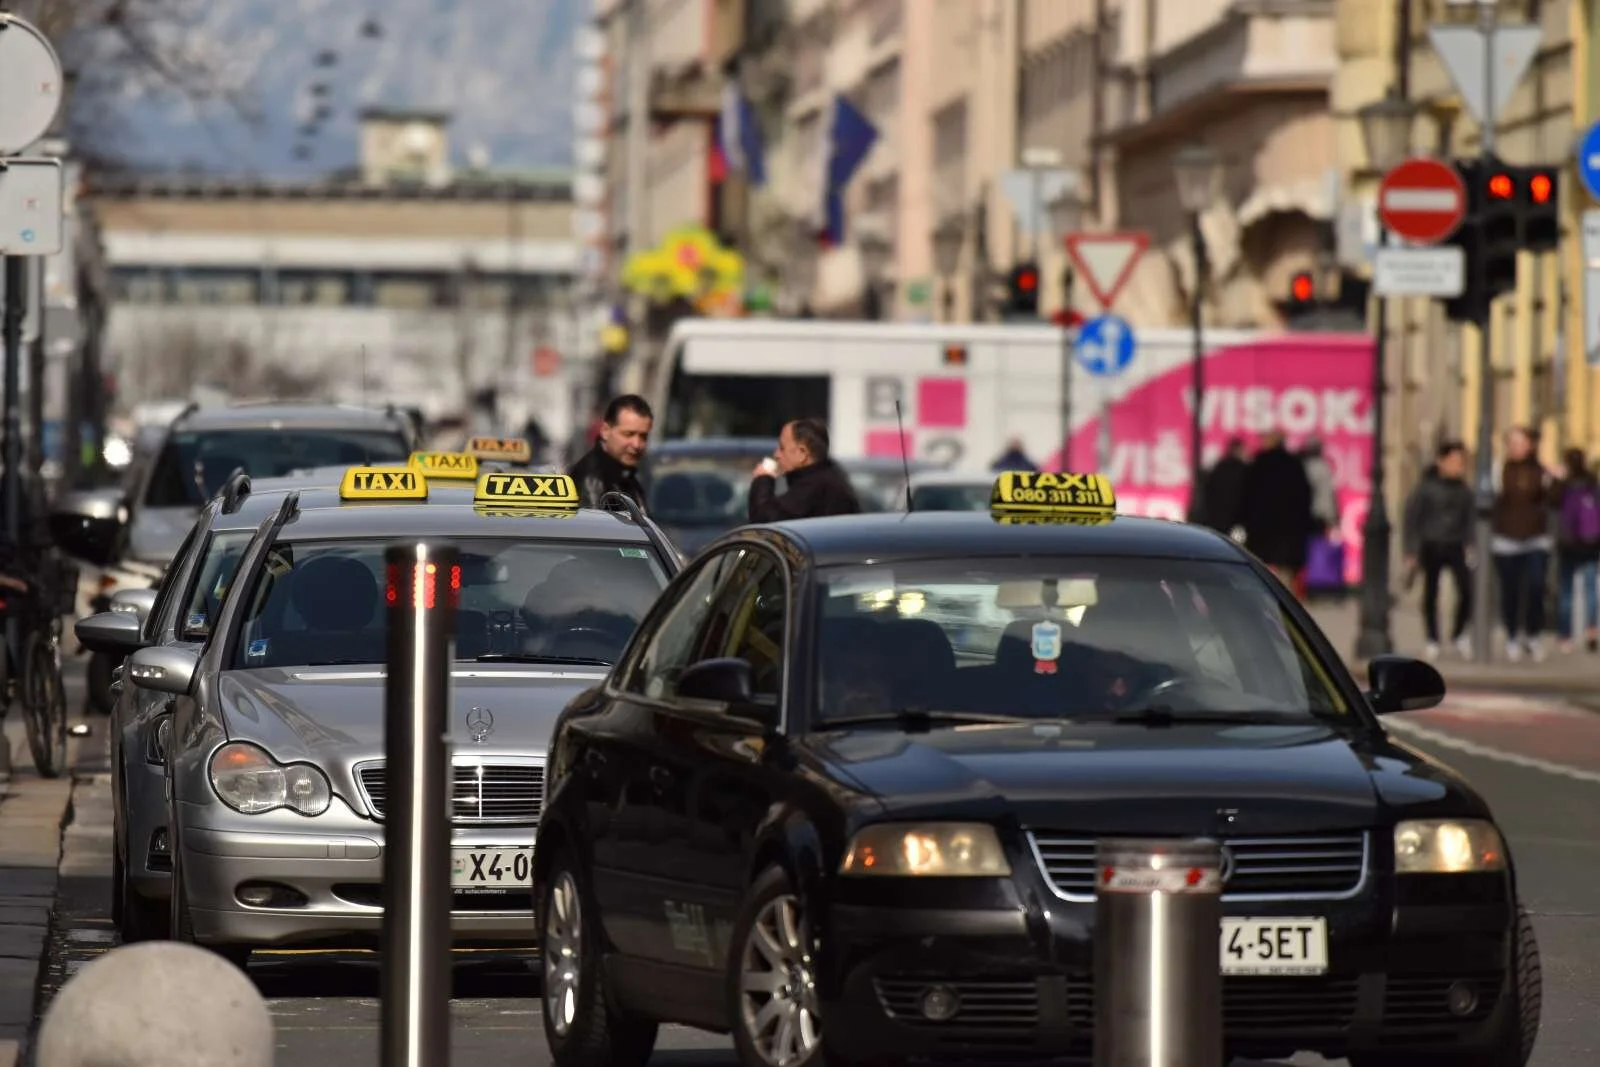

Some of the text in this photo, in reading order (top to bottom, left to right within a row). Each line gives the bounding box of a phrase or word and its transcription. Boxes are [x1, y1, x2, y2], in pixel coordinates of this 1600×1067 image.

[477, 438, 522, 453] TAXI
[430, 453, 472, 469] TAXI
[356, 473, 413, 490] TAXI
[489, 476, 567, 497] TAXI
[1013, 471, 1097, 490] TAXI
[1013, 487, 1100, 505] 080 311 311
[469, 853, 533, 881] X4-0
[1220, 926, 1313, 960] 4-5ET
